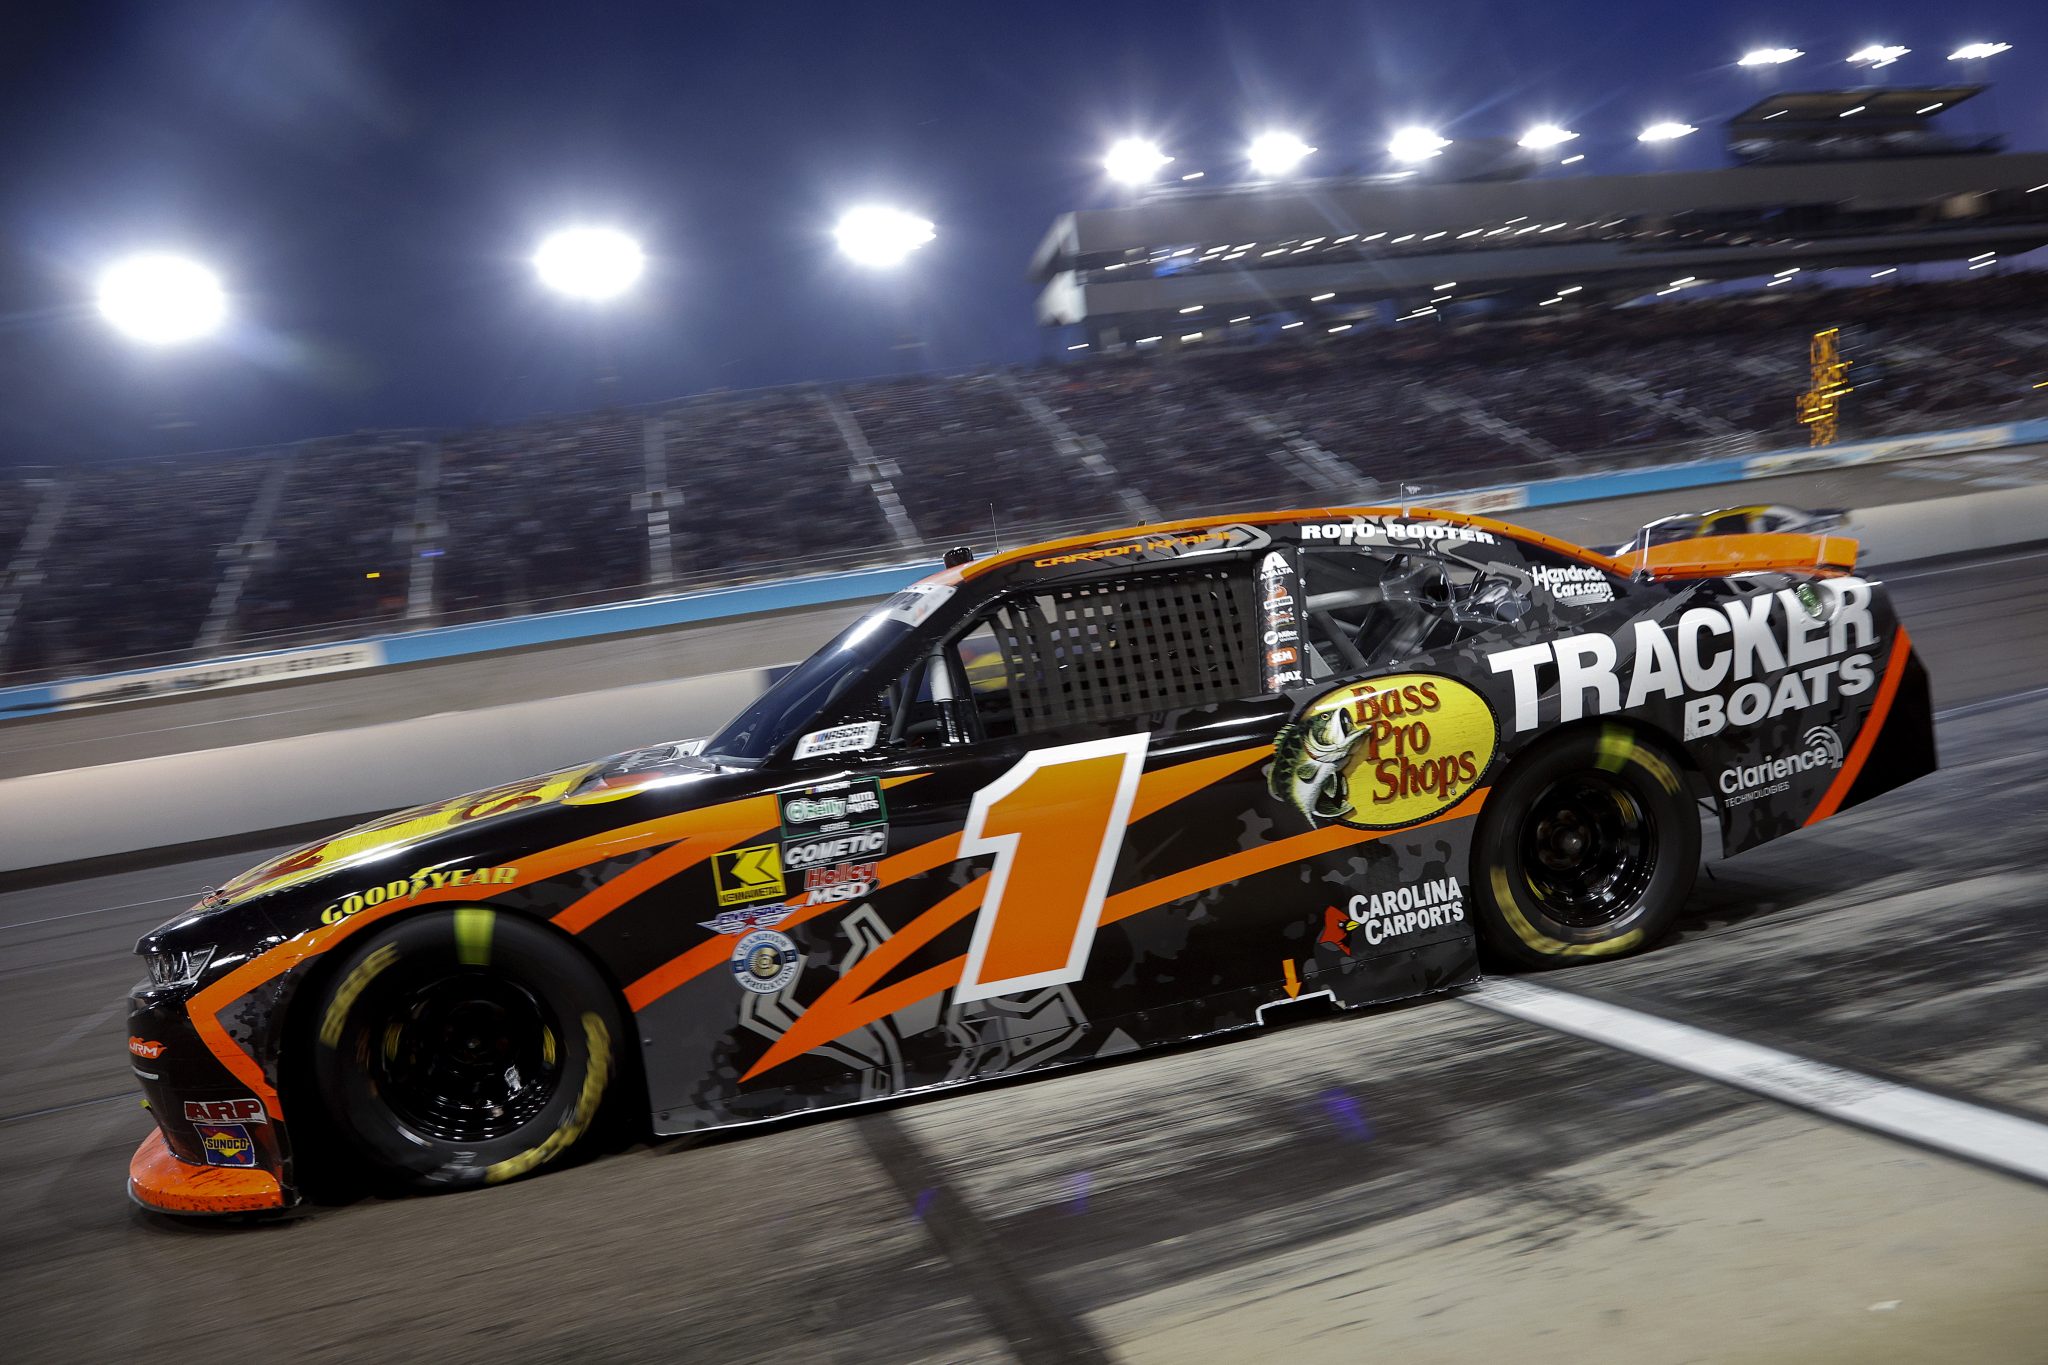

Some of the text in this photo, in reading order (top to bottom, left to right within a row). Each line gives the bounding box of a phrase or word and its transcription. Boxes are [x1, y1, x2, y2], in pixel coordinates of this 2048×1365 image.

[1301, 524, 1495, 545] ROTO-ROOTER
[1034, 544, 1142, 568] CARSON
[1532, 565, 1606, 591] Hendrick
[1552, 581, 1613, 599] Cars.com
[1487, 576, 1880, 732] TRACKER
[1350, 681, 1440, 724] Bass
[1684, 652, 1875, 742] BOATS
[840, 737, 865, 749] CAR
[1367, 720, 1430, 761] Pro
[1373, 750, 1477, 803] Shops
[1719, 746, 1829, 794] Clarience
[1724, 780, 1790, 809] TECHNOLOGIES
[784, 832, 886, 865] COMETIC
[804, 861, 879, 891] Holley
[953, 731, 1151, 1005] 1
[806, 881, 871, 906] MSD
[1349, 876, 1464, 924] CAROLINA
[1365, 901, 1464, 945] CARPORTS
[185, 1100, 261, 1120] ARP
[206, 1138, 249, 1150] SUNOCO
